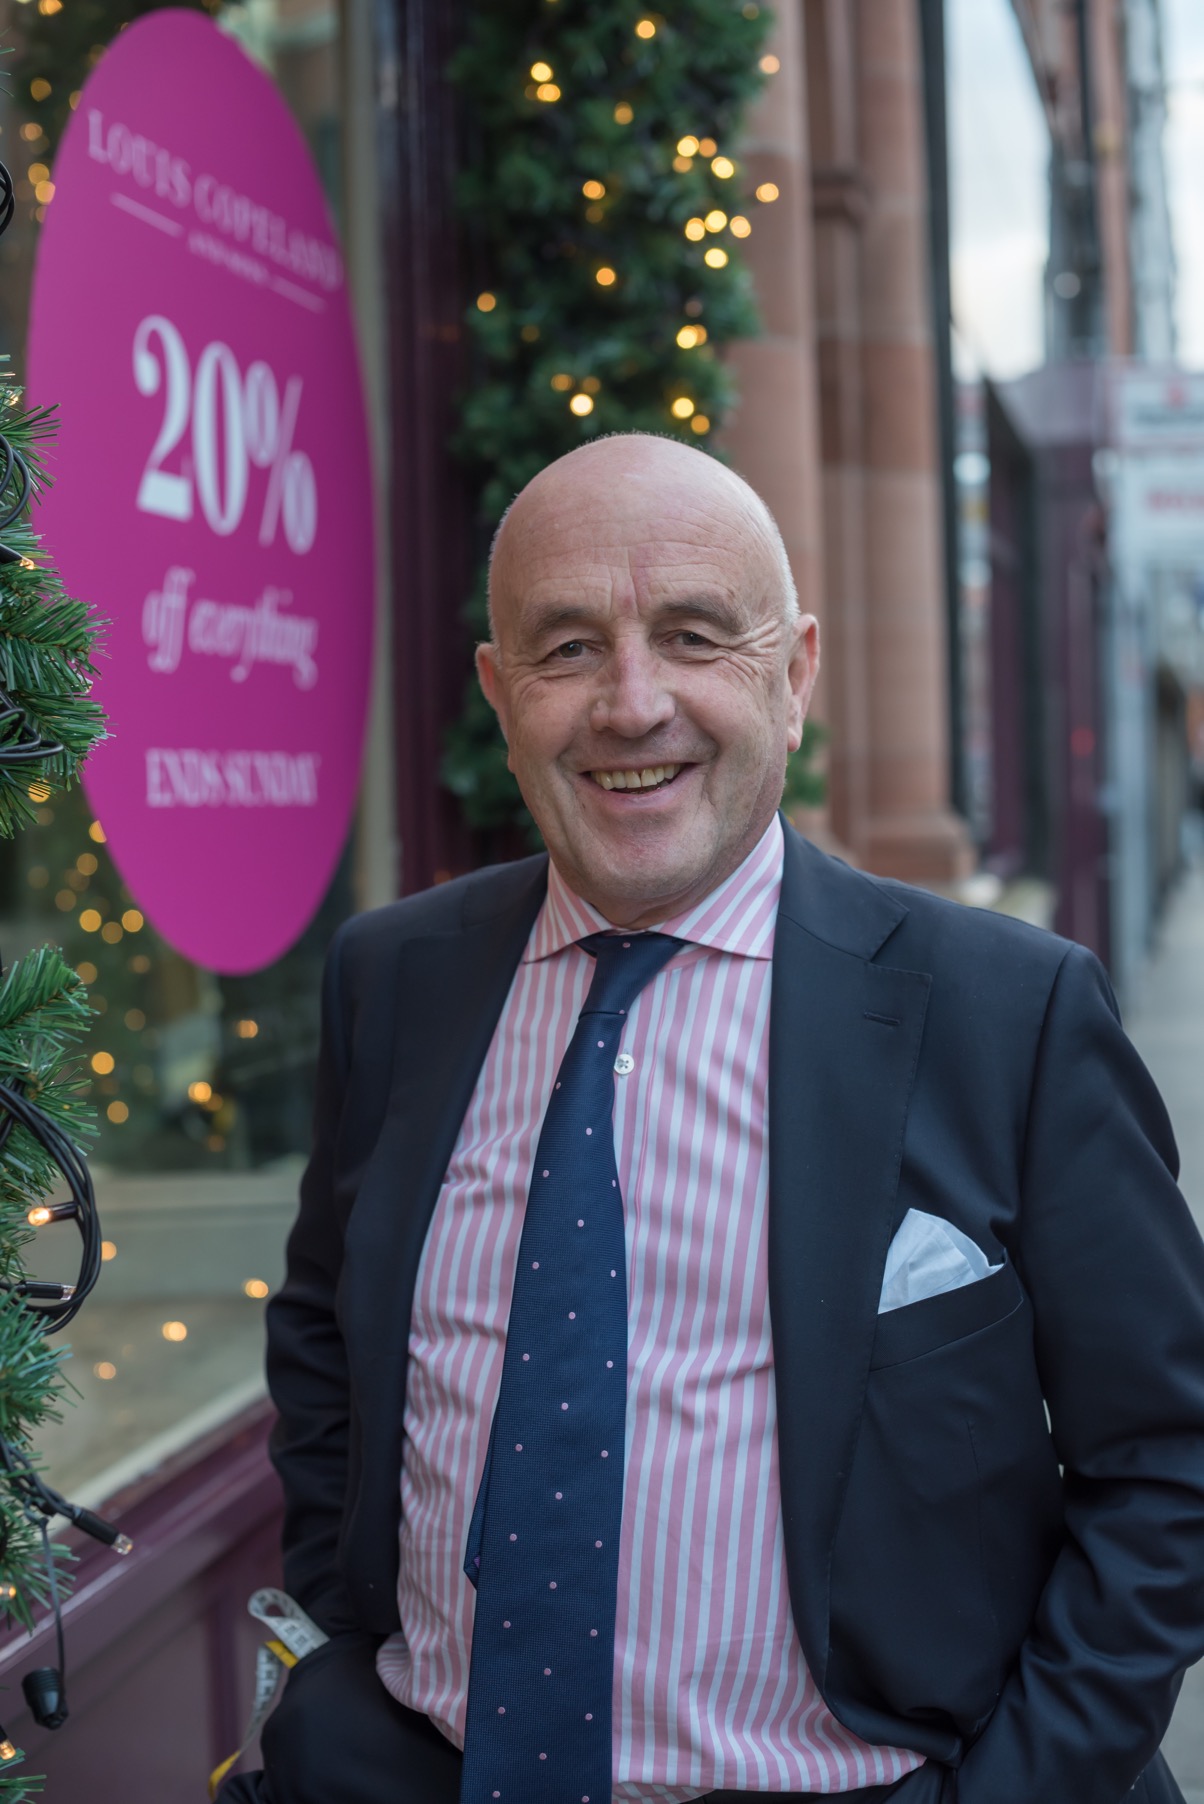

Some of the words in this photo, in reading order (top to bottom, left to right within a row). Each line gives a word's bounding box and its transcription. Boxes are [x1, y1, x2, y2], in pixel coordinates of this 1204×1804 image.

[88, 108, 191, 209] LOUIS
[193, 173, 343, 293] COPELAND
[132, 314, 318, 556] 20%
[142, 565, 195, 674] off
[146, 748, 223, 808] ENDS
[222, 749, 322, 808] SUNDAY
